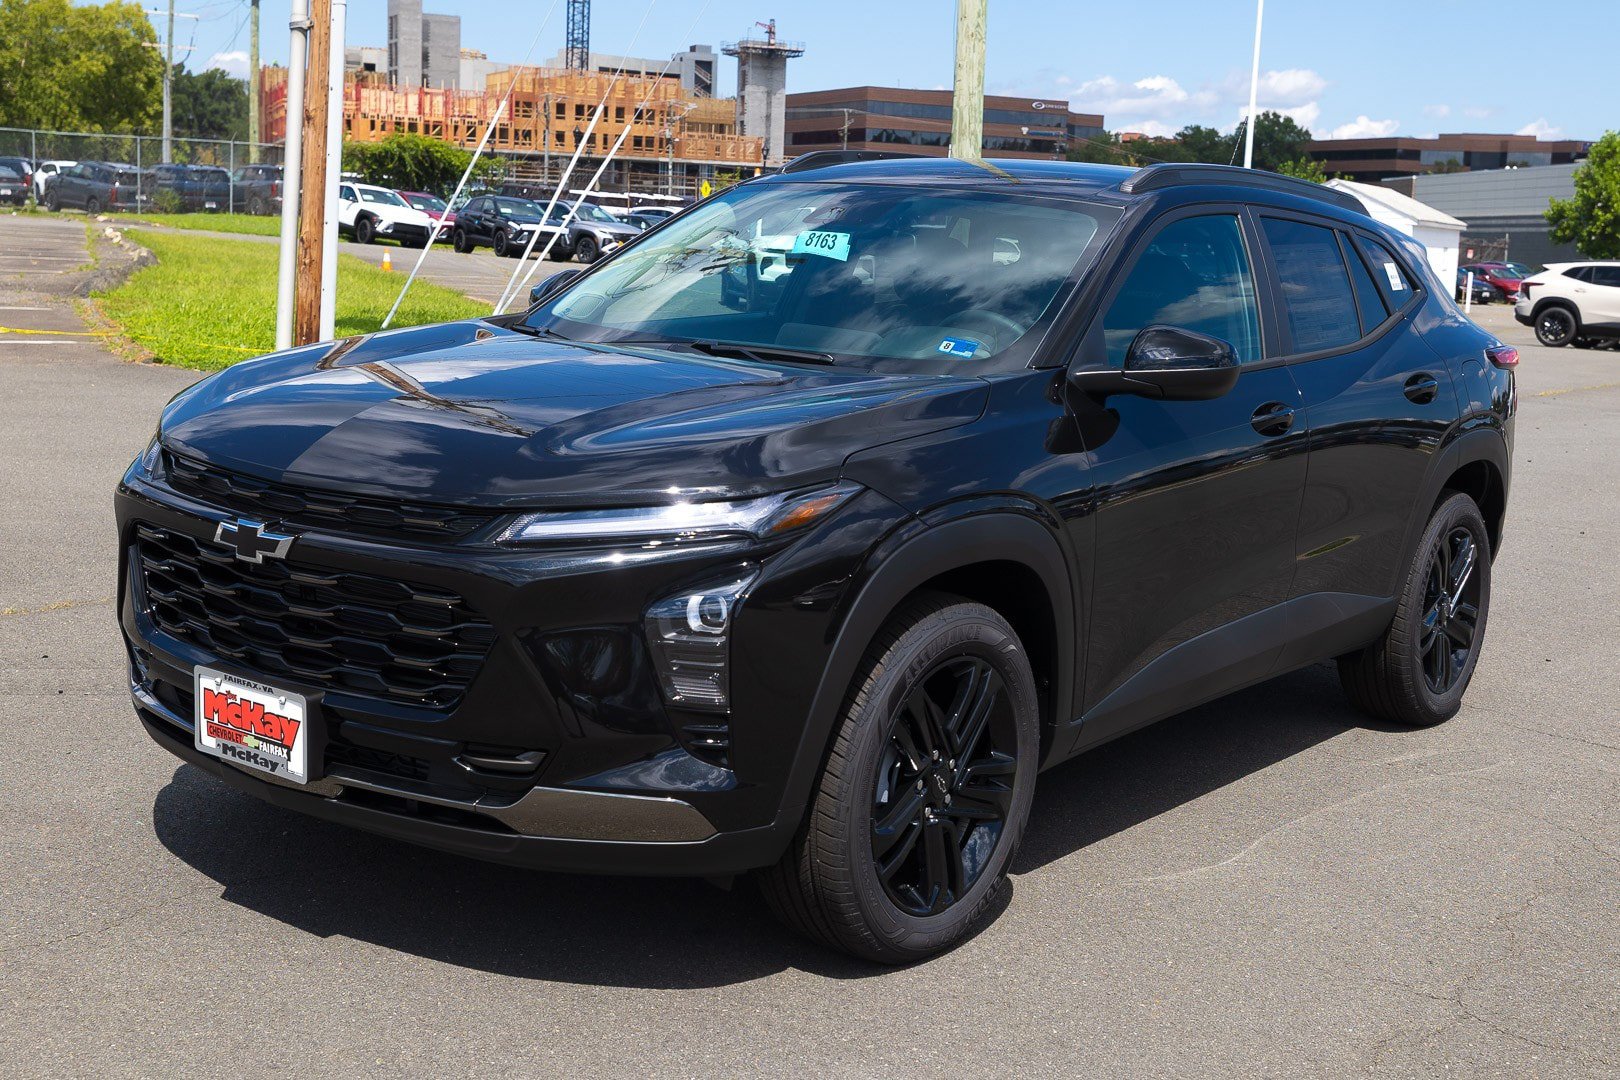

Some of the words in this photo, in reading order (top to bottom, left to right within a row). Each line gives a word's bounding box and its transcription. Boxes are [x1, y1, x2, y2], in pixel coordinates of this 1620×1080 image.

[805, 232, 838, 250] 8163
[943, 342, 951, 350] 8
[262, 686, 274, 694] VA
[204, 688, 301, 750] McKay
[209, 725, 243, 744] CHEVROLET
[222, 743, 280, 773] McKay
[259, 741, 288, 759] FAIRFAX
